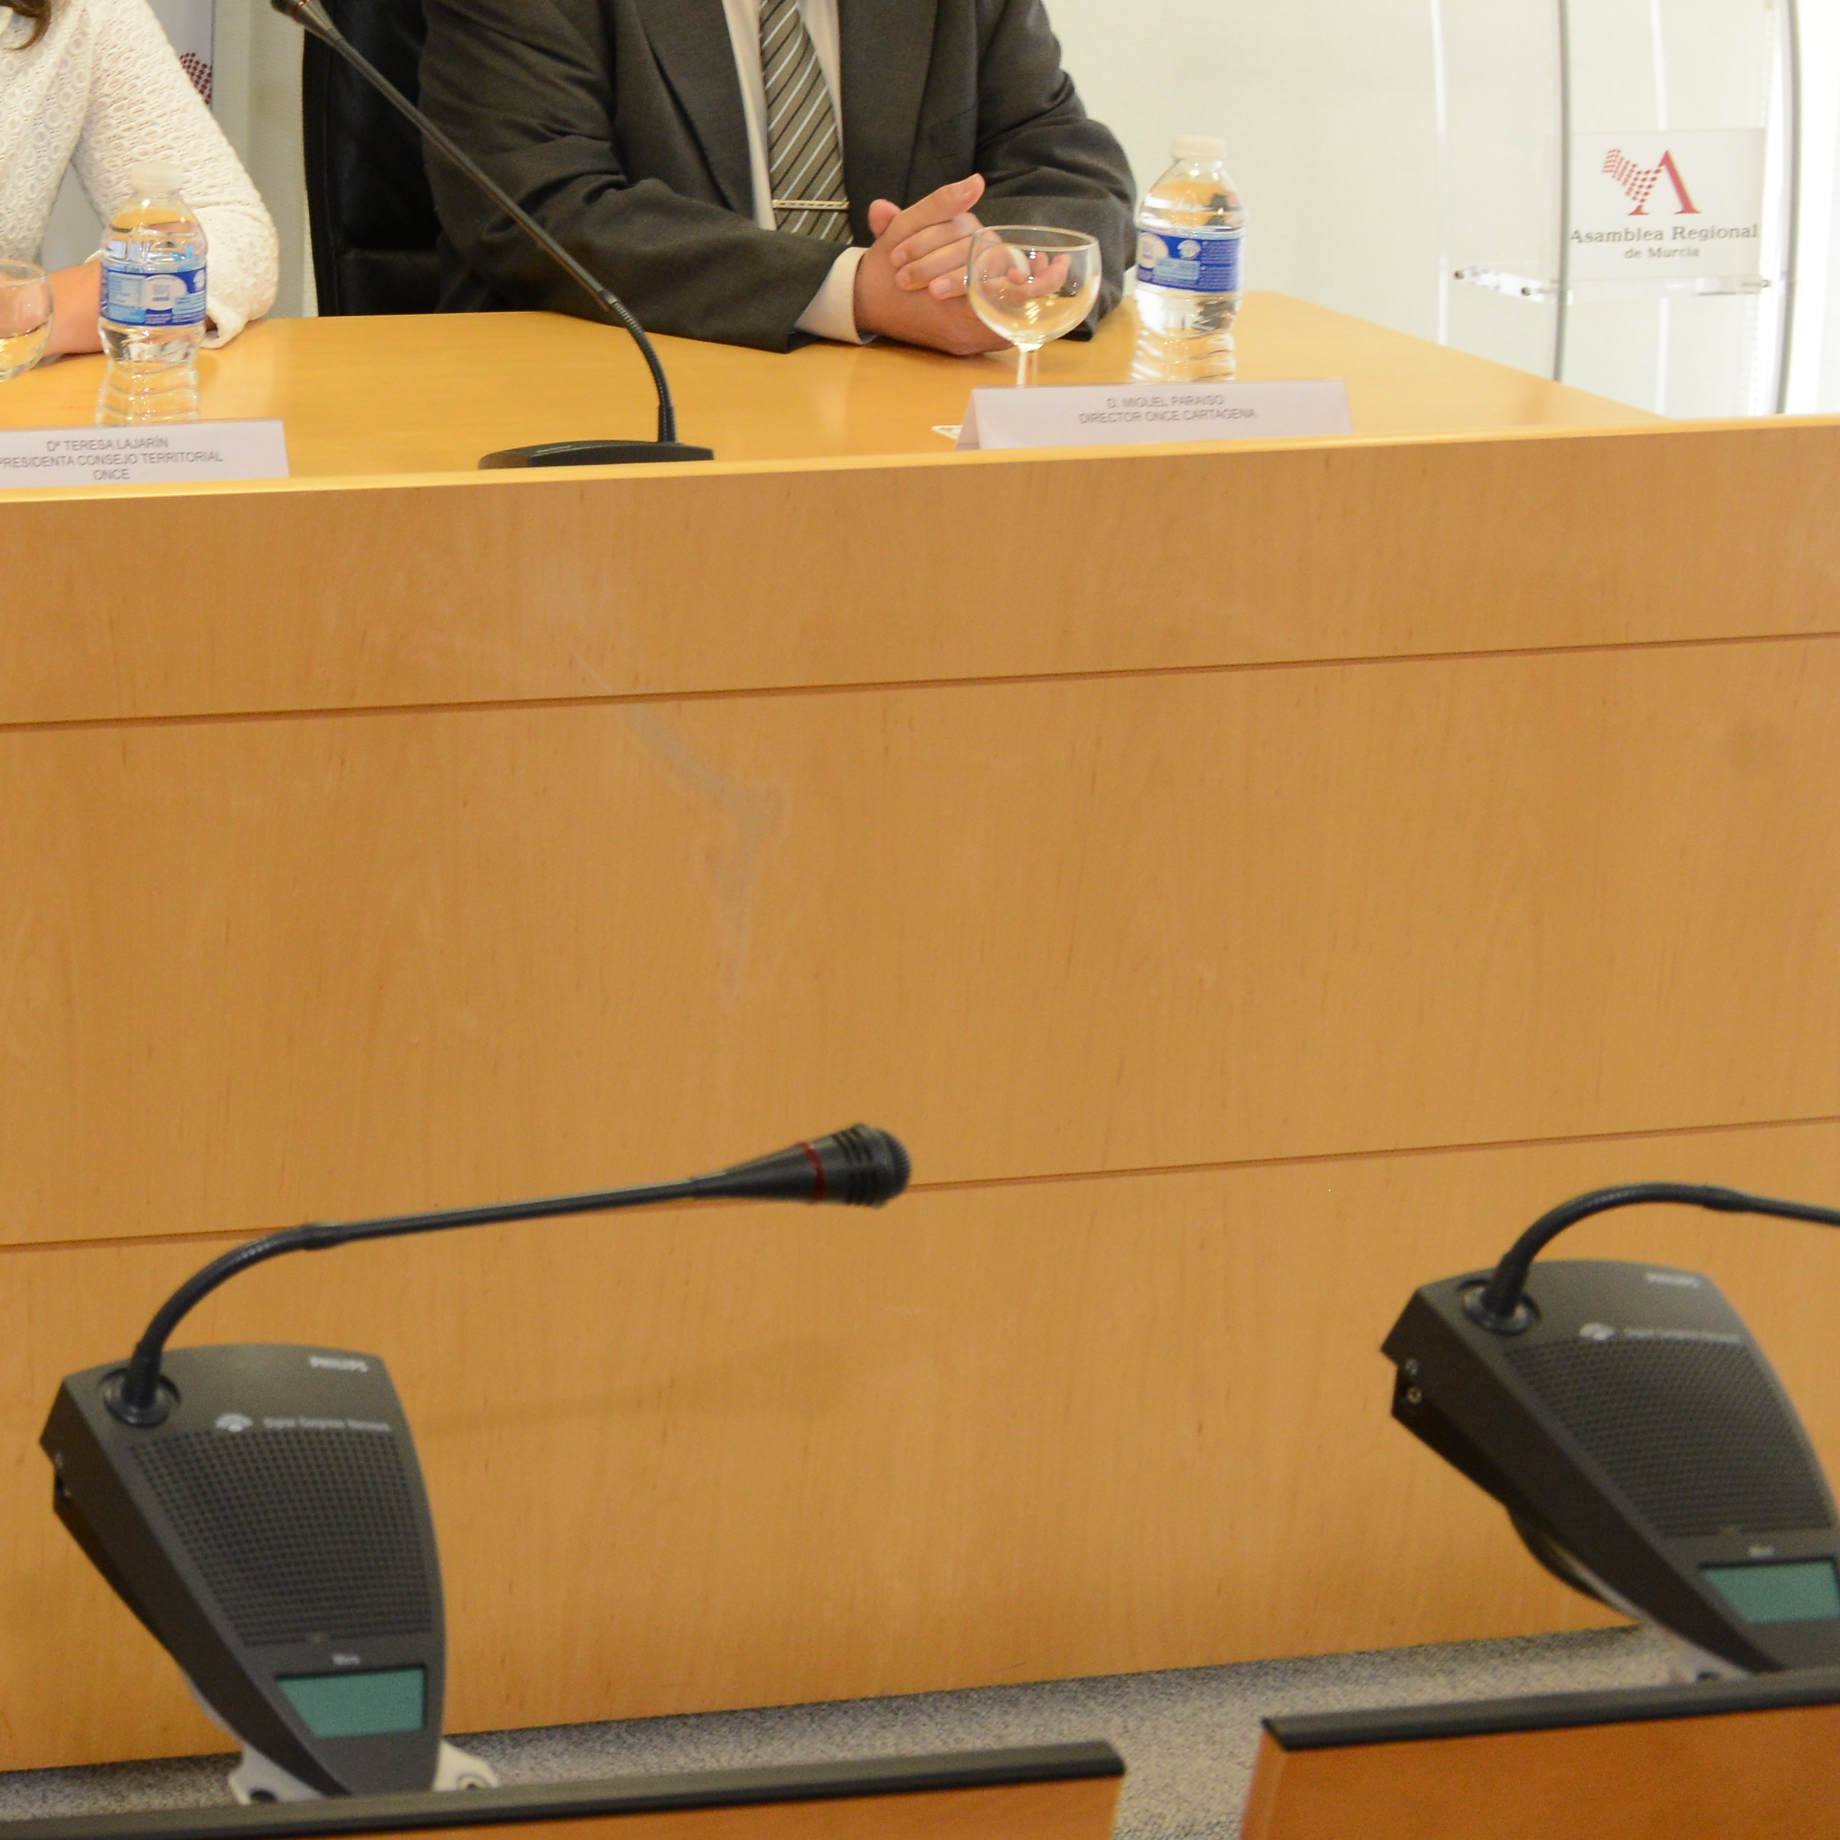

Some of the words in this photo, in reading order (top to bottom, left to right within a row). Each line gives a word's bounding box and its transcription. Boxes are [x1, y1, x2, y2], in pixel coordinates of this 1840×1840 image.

[1570, 227, 1664, 244] Asamblea
[1672, 224, 1759, 243] Regional
[1624, 248, 1642, 260] de
[1647, 246, 1700, 259] Murcia
[1079, 411, 1142, 425] DIRECTOR
[1183, 408, 1258, 422] CARTAGENA
[63, 438, 113, 452] TERESA
[72, 453, 138, 466] CONSEJO
[140, 450, 224, 465] TERRITORIAL
[92, 468, 131, 481] ONCE
